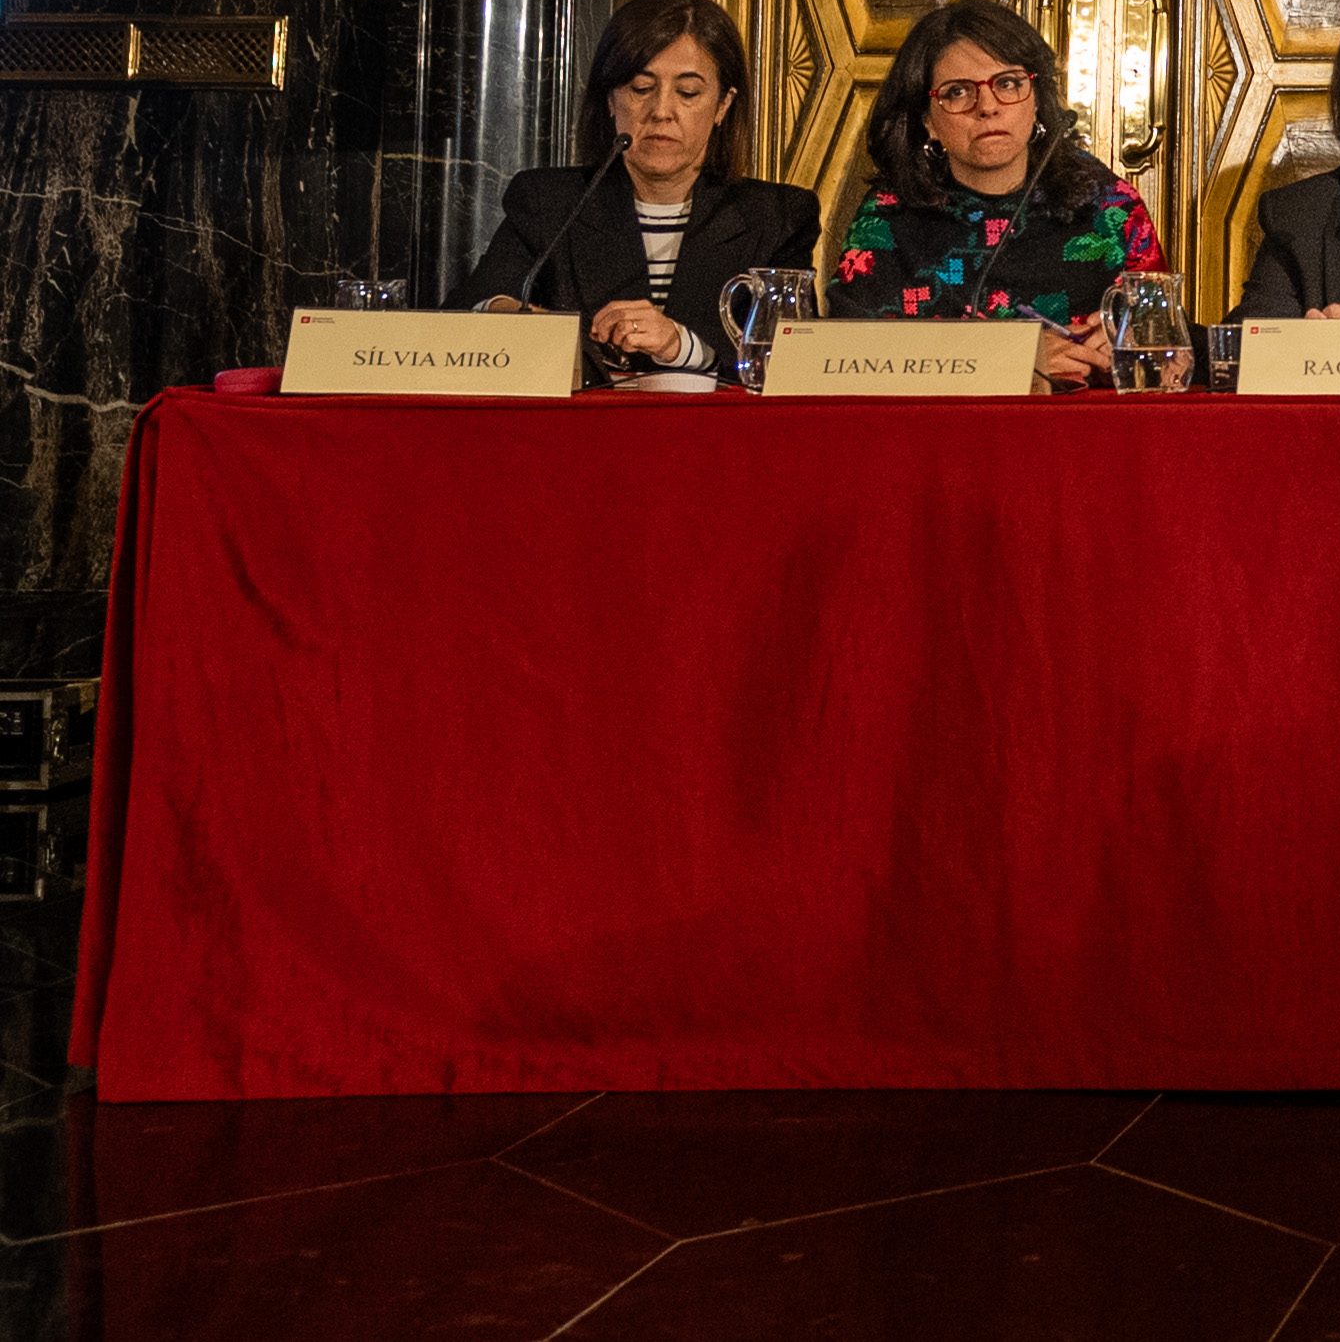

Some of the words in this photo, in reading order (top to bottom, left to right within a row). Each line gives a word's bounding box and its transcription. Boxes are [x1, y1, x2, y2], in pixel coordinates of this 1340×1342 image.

[352, 345, 437, 367] SÍLVIA
[443, 347, 511, 369] MIRÓ
[822, 358, 895, 374] LIANA
[902, 358, 978, 375] REYES
